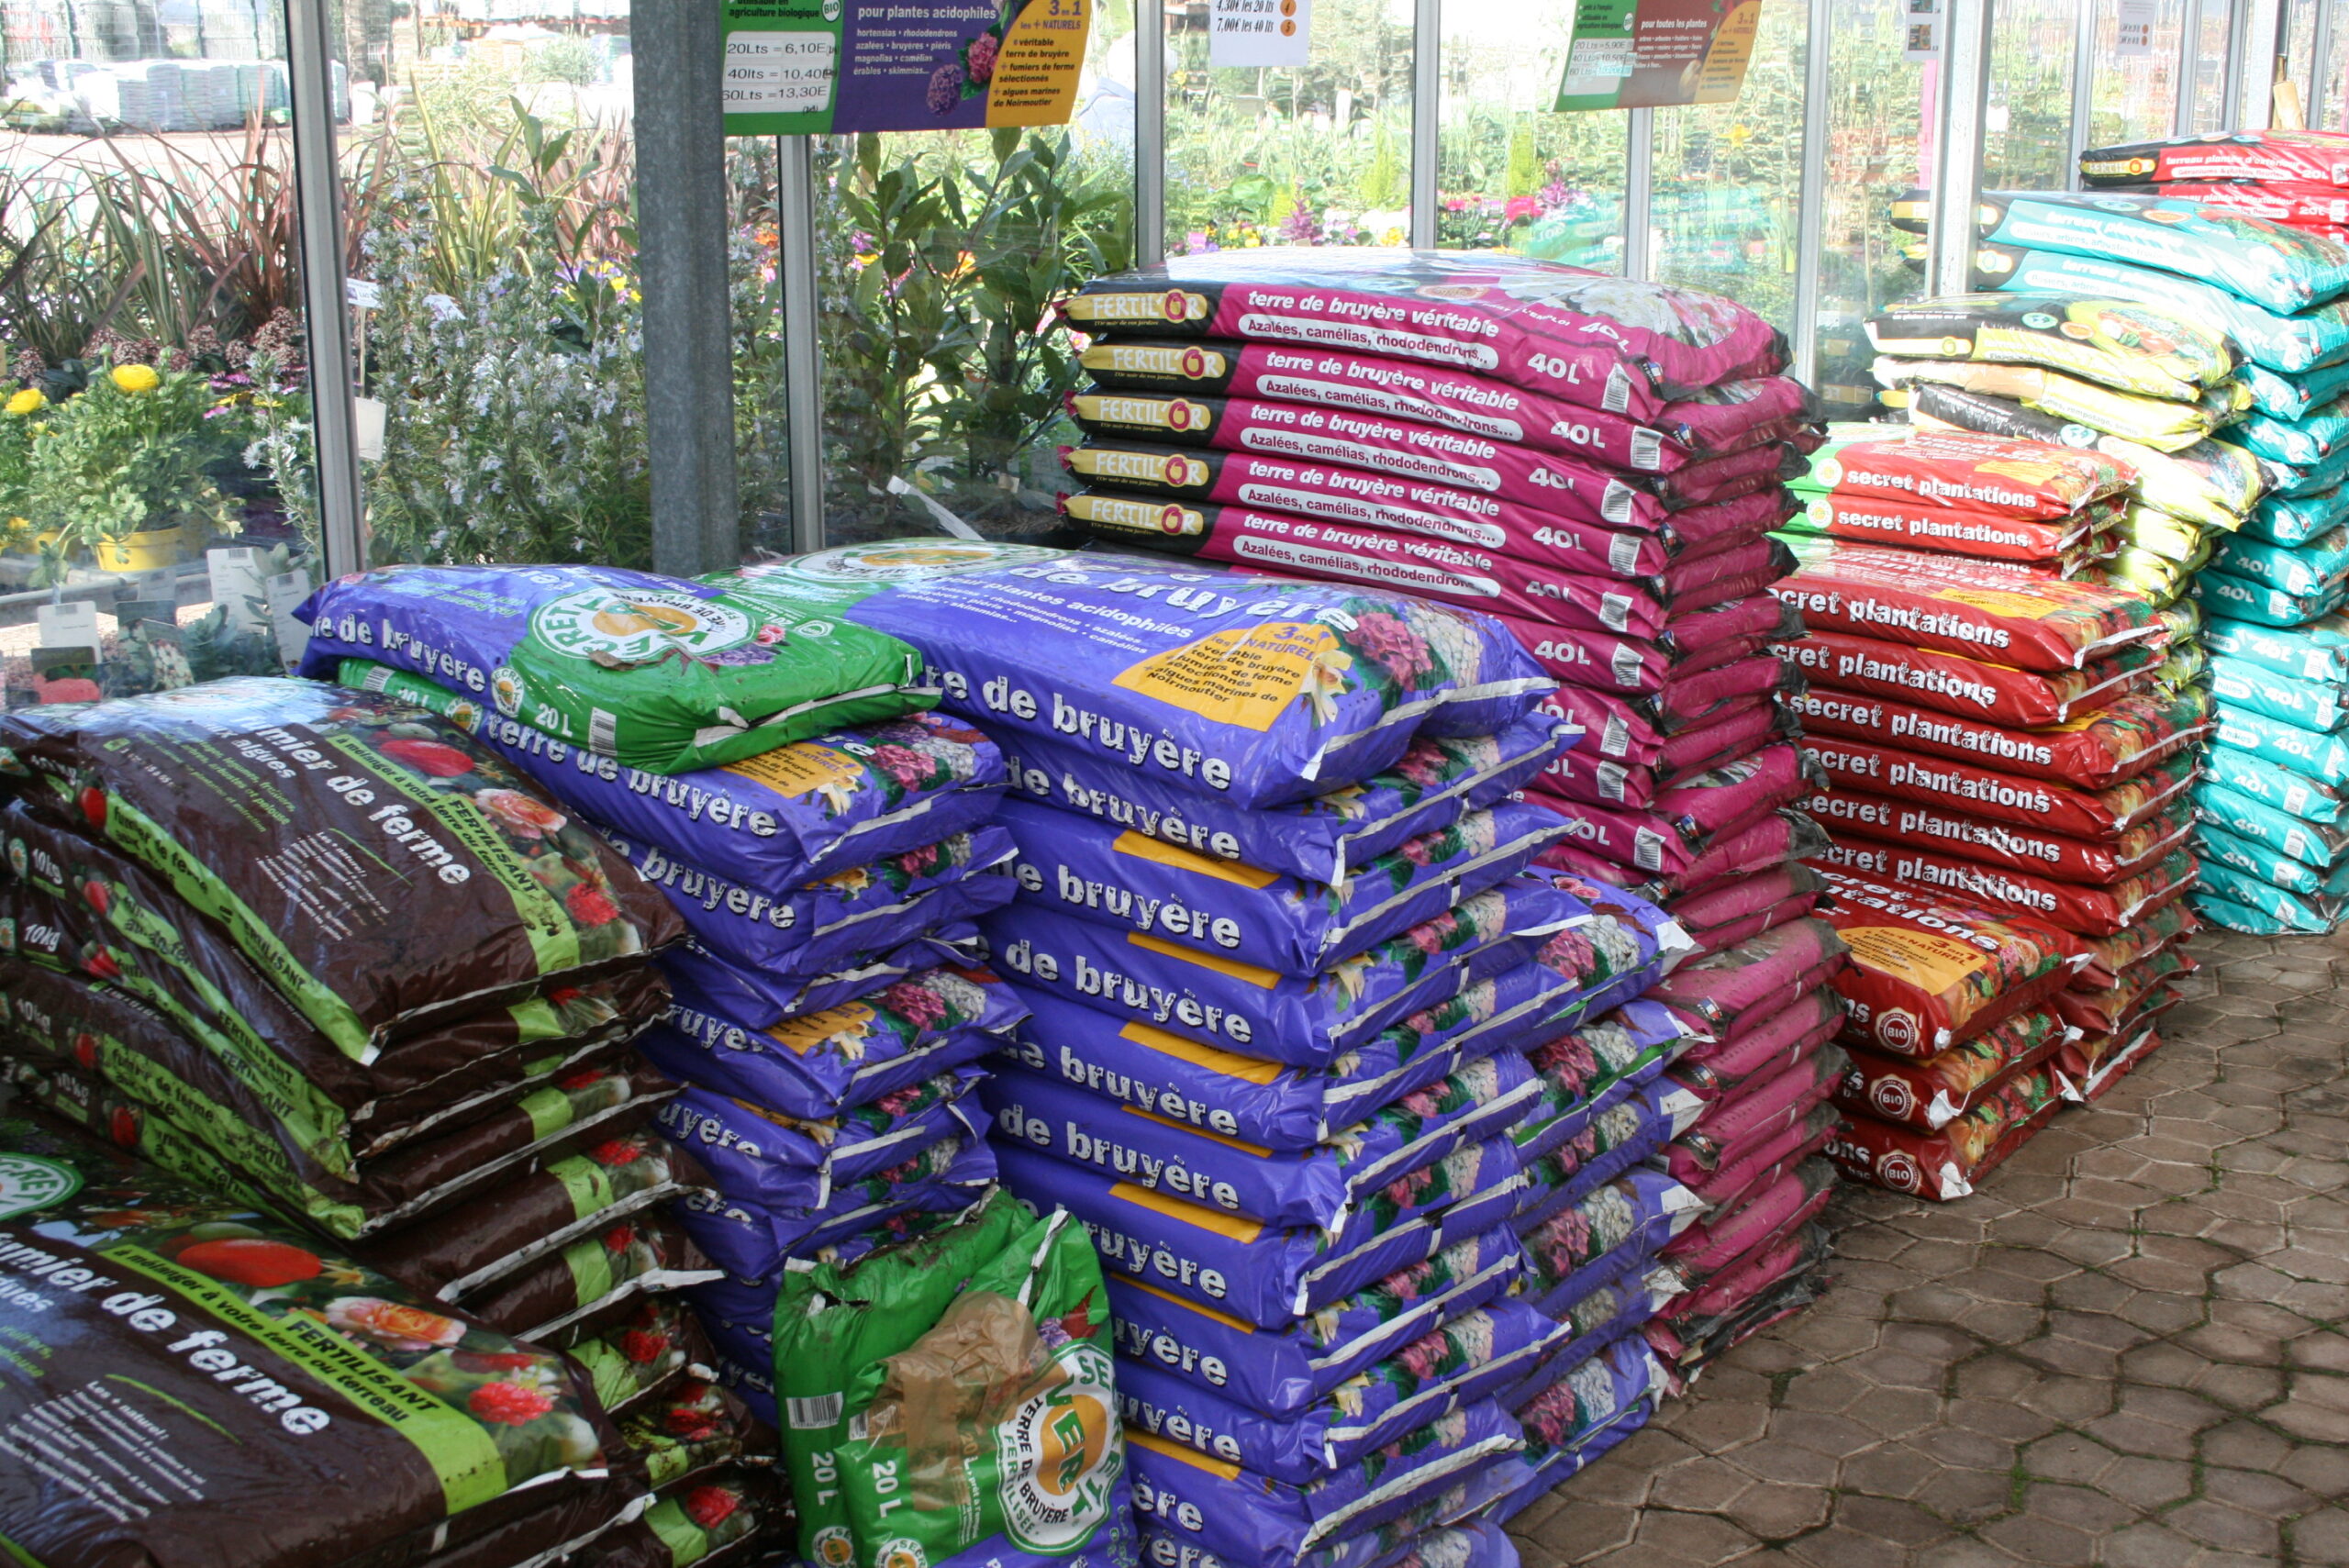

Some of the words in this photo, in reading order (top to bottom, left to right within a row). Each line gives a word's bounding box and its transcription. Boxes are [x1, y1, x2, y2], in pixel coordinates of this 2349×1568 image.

[729, 8, 775, 18] agriculture
[778, 7, 819, 18] biologique
[824, 2, 839, 15] BIO
[858, 7, 885, 20] pour
[887, 6, 930, 20] plantes
[932, 6, 996, 22] acidophiles
[1049, 1, 1060, 16] 3
[1072, 1, 1081, 16] 1
[1253, 1, 1264, 13] 20
[856, 28, 896, 37] hortensias
[904, 28, 957, 37] rhododendrons
[1042, 20, 1081, 29] NATURELS
[1217, 18, 1241, 33] 7,00€
[1241, 18, 1252, 32] les
[1254, 20, 1264, 32] 40
[1641, 21, 1655, 30] pour
[1656, 19, 1675, 28] toutes
[1675, 19, 1685, 28] les
[1686, 19, 1707, 30] plantes
[785, 43, 826, 55] 6,10E
[855, 40, 884, 50] azalées
[891, 40, 924, 51] bruyères
[930, 40, 952, 51] piéris
[1019, 38, 1054, 46] véritable
[1041, 50, 1069, 59] bruyère
[853, 66, 881, 74] érables
[854, 54, 892, 64] magnolias
[900, 53, 932, 62] camélias
[1009, 62, 1040, 71] fumiers
[1041, 62, 1052, 71] de
[1053, 62, 1075, 71] ferme
[779, 86, 827, 99] 13,30E
[998, 74, 1049, 83] sélectionnés
[1002, 87, 1028, 96] algues
[994, 99, 1004, 107] de
[1006, 98, 1052, 107] Noirmoutier
[2165, 155, 2202, 165] terreau
[2302, 169, 2329, 180] 20L
[1248, 291, 1295, 309] terre
[1299, 294, 1324, 311] de
[1330, 297, 1406, 323] bruyère
[1411, 308, 1499, 337] véritable
[1248, 318, 1302, 339] Azalées,
[1306, 325, 1372, 346] camélias,
[1266, 351, 1313, 371] terre
[1319, 356, 1342, 375] de
[1347, 361, 1425, 391] bruyère
[1431, 381, 1520, 411] véritable
[1528, 352, 1581, 385] 40L
[1266, 380, 1321, 400] Azalées,
[1325, 389, 1390, 411] camélias,
[1251, 405, 1296, 424] terre
[1300, 408, 1324, 428] de
[1329, 413, 1402, 441] bruyère
[1408, 428, 1496, 460] véritable
[1551, 420, 1606, 449] 40L
[1249, 461, 1295, 481] terre
[1299, 468, 1324, 485] de
[1329, 472, 1405, 498] bruyère
[1410, 486, 1499, 516] véritable
[1847, 469, 1914, 491] secret
[1918, 479, 2036, 508] plantations
[1248, 489, 1302, 510] Azalées,
[1306, 500, 1372, 520] camélias,
[1533, 526, 1587, 551] 40L
[1837, 510, 1904, 532] secret
[1909, 518, 2030, 547] plantations
[985, 582, 1065, 606] plantes
[1066, 600, 1194, 639] acidophiles
[990, 595, 1083, 626] rhododendrons
[1849, 598, 2009, 649] plantations
[340, 613, 372, 645] de
[1014, 609, 1078, 633] magnolias
[1089, 633, 1148, 654] camélias
[1245, 638, 1316, 662] NATUREL
[1534, 640, 1591, 665] 40L
[1176, 654, 1228, 672] fumiers
[1251, 672, 1293, 686] ferme
[1247, 661, 1301, 679] bruyère
[1839, 653, 1997, 706] plantations
[1147, 673, 1230, 704] Noirmoutier
[1203, 679, 1258, 698] marines
[534, 703, 559, 729] 20
[1790, 695, 1882, 728] secret
[1891, 714, 2053, 765] plantations
[488, 713, 567, 762] terre
[982, 675, 1038, 720] de
[1053, 693, 1232, 790] bruyère
[231, 739, 296, 780] algues
[2273, 738, 2313, 759] 40L
[1890, 762, 2051, 813] plantations
[327, 775, 375, 806] de
[368, 804, 471, 884] ferme
[1063, 773, 1240, 860] bruyère
[449, 799, 540, 894] FERTILISANT
[1900, 811, 2061, 862] plantations
[1898, 858, 2056, 911] plantations
[1058, 864, 1241, 949] bruyère
[24, 924, 61, 952] 10kg
[1006, 939, 1058, 981] de
[1075, 955, 1252, 1043] bruyère
[1887, 1028, 1908, 1040] BIO
[1061, 1045, 1239, 1136] bruyère
[999, 1104, 1051, 1146] de
[1066, 1121, 1240, 1210] bruyère
[129, 1253, 206, 1294] mélanger
[216, 1299, 264, 1332] votre
[263, 1327, 311, 1360] terre
[309, 1357, 334, 1375] ou
[332, 1367, 411, 1423] terreau
[101, 1291, 176, 1331] de
[165, 1329, 331, 1435] ferme
[286, 1319, 440, 1413] FERTILISANT
[1016, 1396, 1043, 1453] TERRE
[812, 1451, 837, 1483] 20
[873, 1460, 899, 1494] 20
[817, 1489, 835, 1506] L
[880, 1498, 902, 1518] L
[1019, 1483, 1069, 1524] BRUYÈRE
